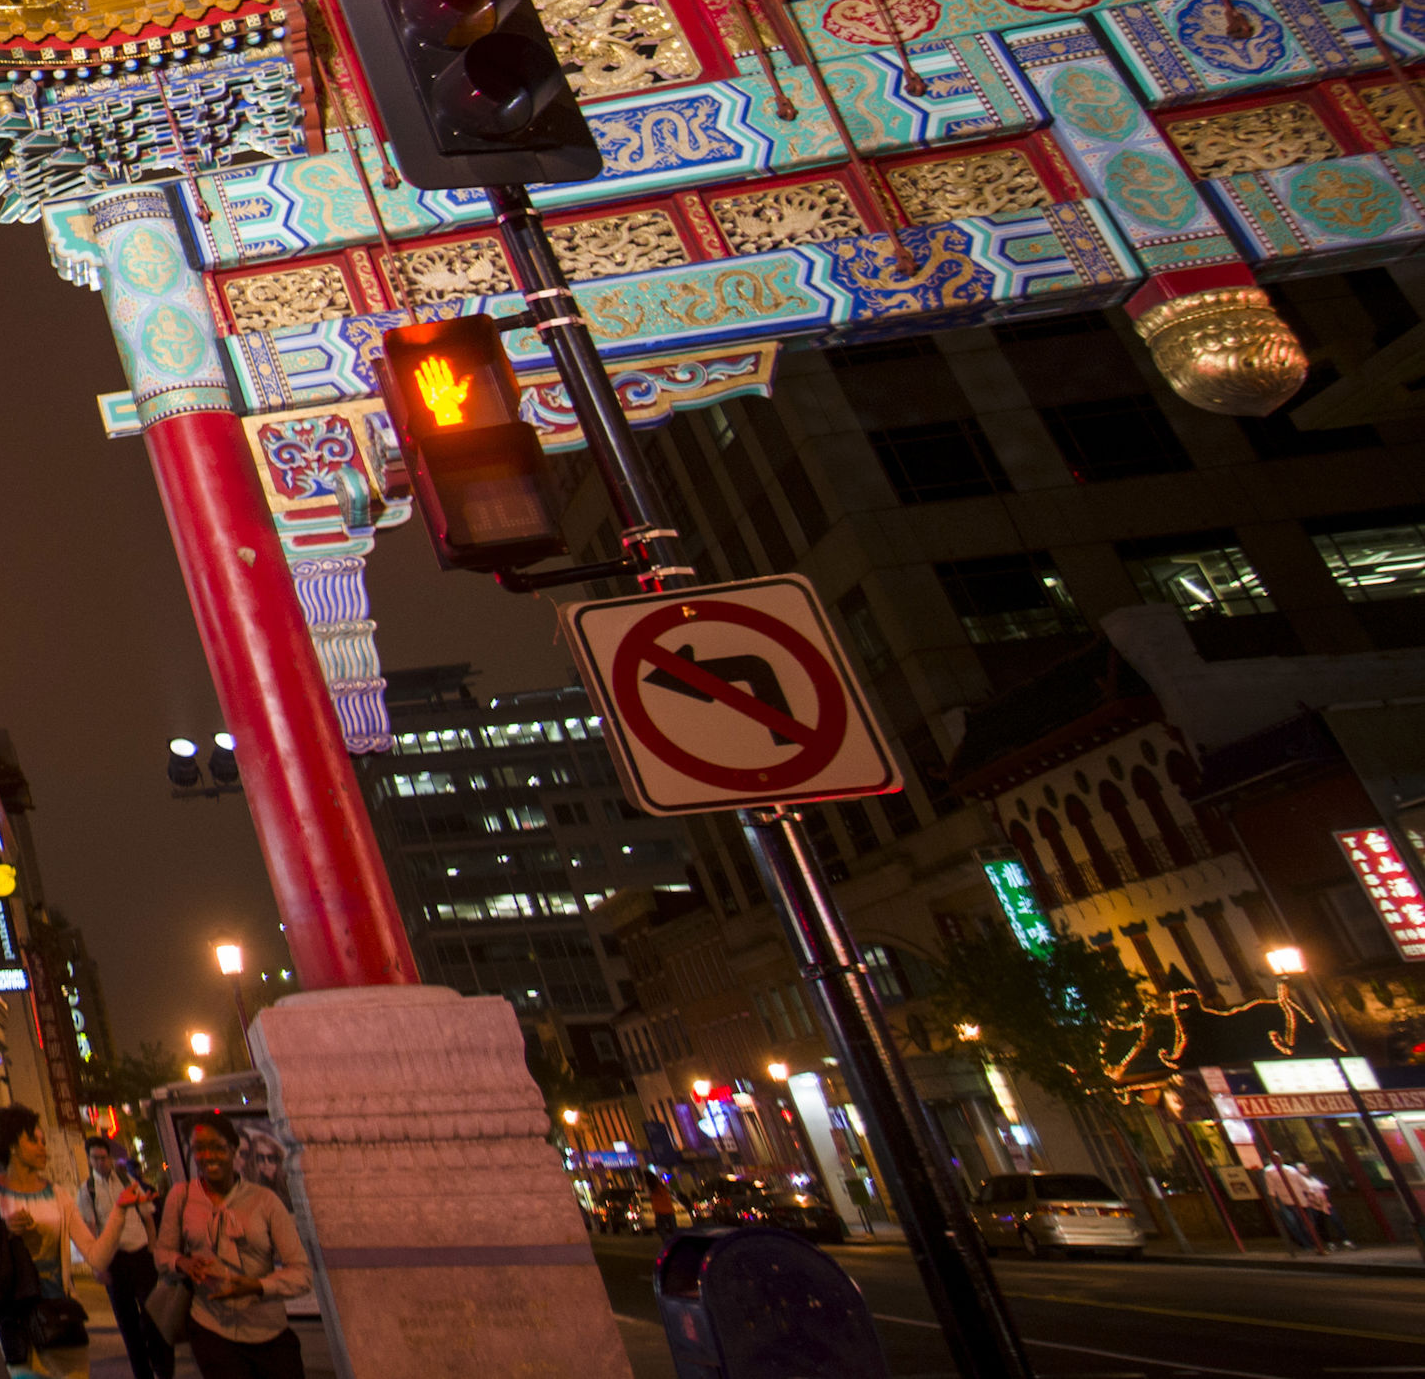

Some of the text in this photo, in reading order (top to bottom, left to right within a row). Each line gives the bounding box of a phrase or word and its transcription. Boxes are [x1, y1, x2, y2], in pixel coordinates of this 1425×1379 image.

[1237, 1098, 1267, 1116] TAI
[1268, 1095, 1316, 1114] SHAN
[1316, 1092, 1388, 1112] CHINSE
